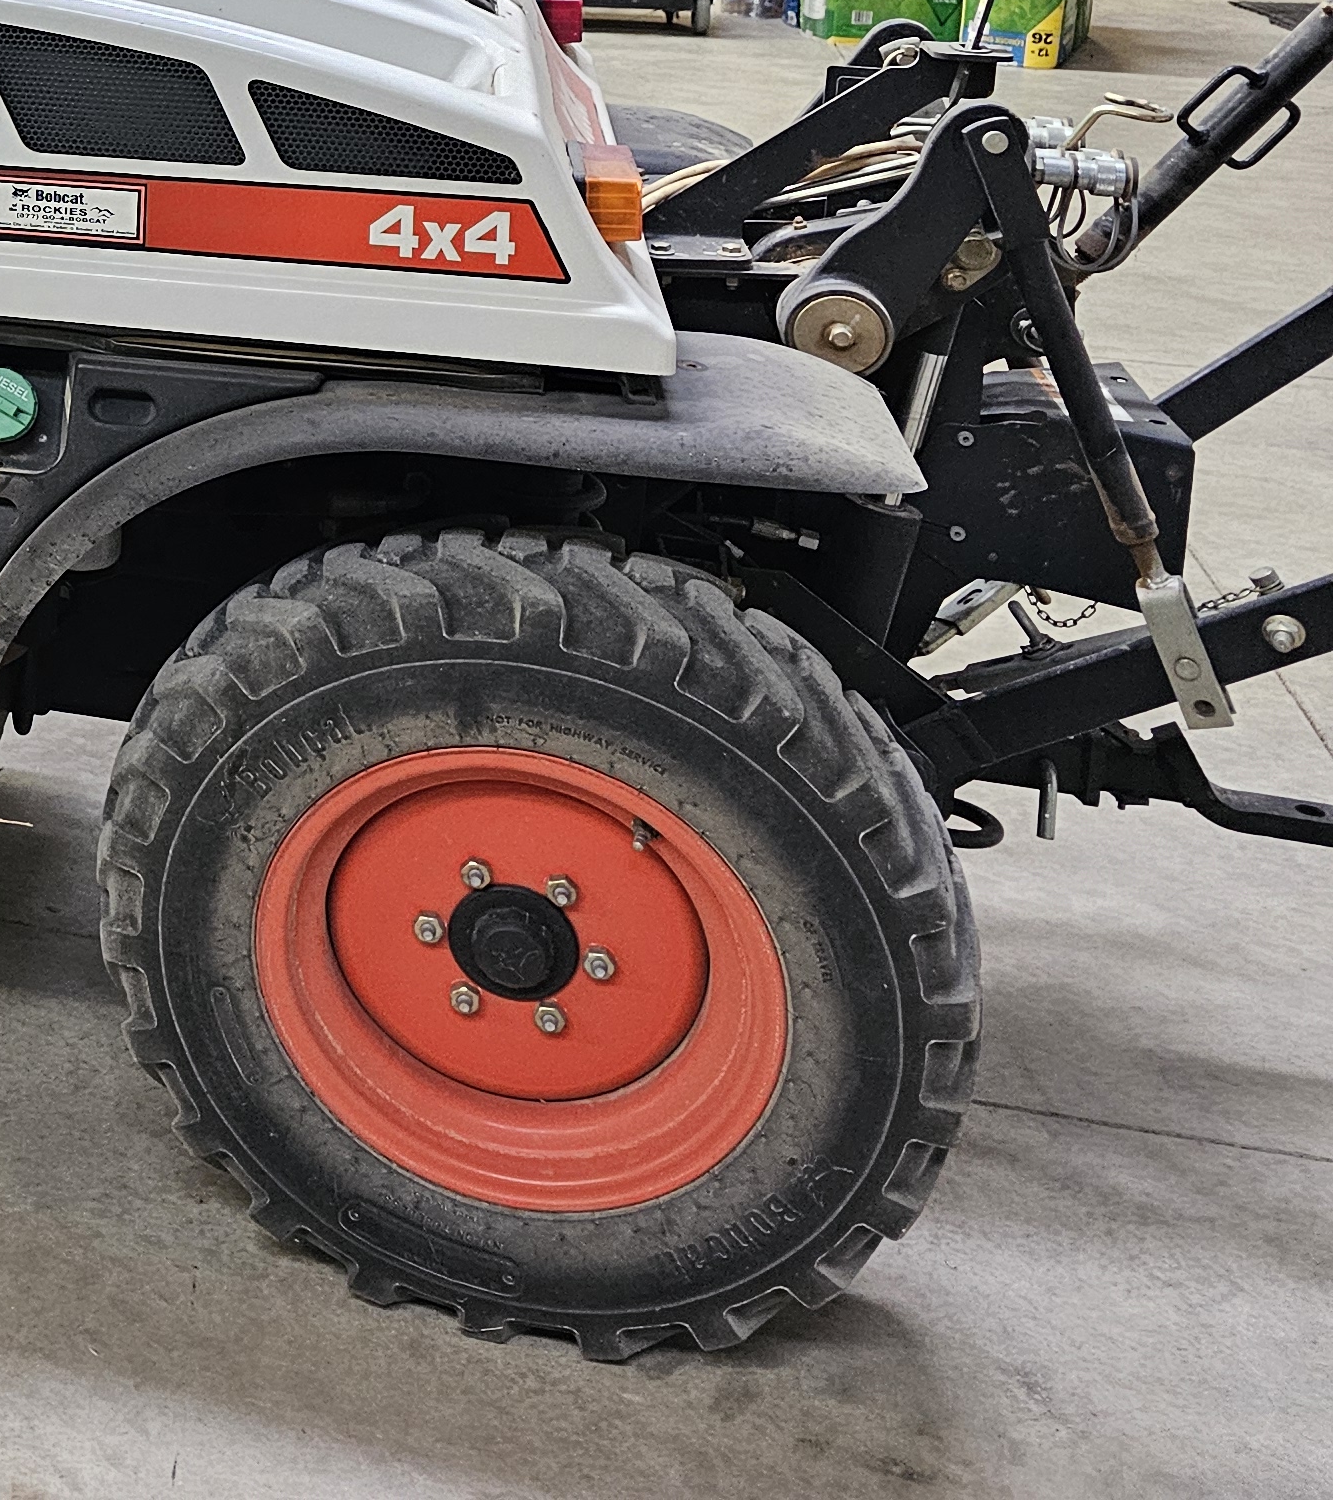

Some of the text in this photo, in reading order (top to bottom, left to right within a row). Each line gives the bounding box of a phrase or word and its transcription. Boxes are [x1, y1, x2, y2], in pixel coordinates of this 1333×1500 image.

[1031, 32, 1053, 44] 26
[35, 189, 85, 205] Bobcat
[21, 204, 88, 217] ROCKIES
[369, 204, 515, 265] 4x4
[485, 714, 667, 777] NOT FOR HIGHWAY SERVICE
